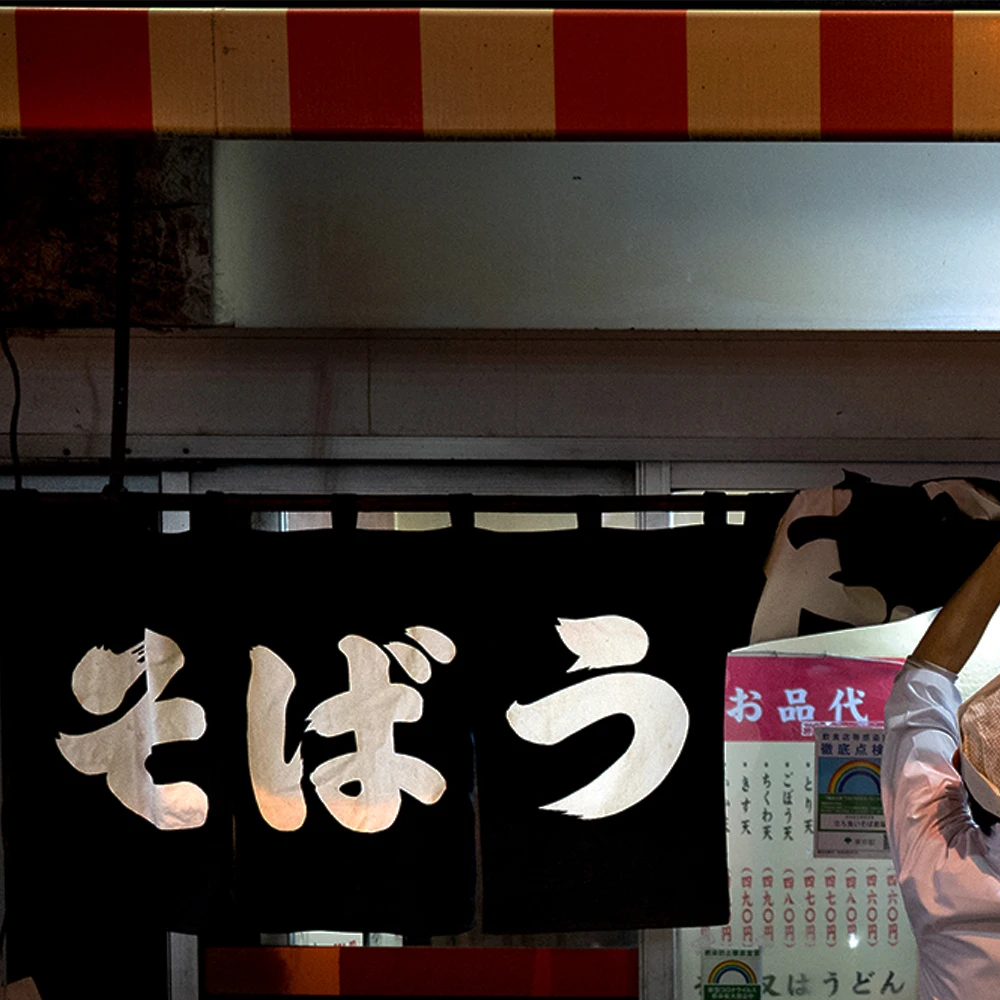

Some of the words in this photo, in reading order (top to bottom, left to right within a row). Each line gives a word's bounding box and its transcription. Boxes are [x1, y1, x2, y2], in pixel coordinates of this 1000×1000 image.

[726, 687, 869, 723] お品代
[762, 774, 773, 840] ちくわ天
[782, 772, 794, 841] ごぼう天
[804, 776, 814, 834] とり天
